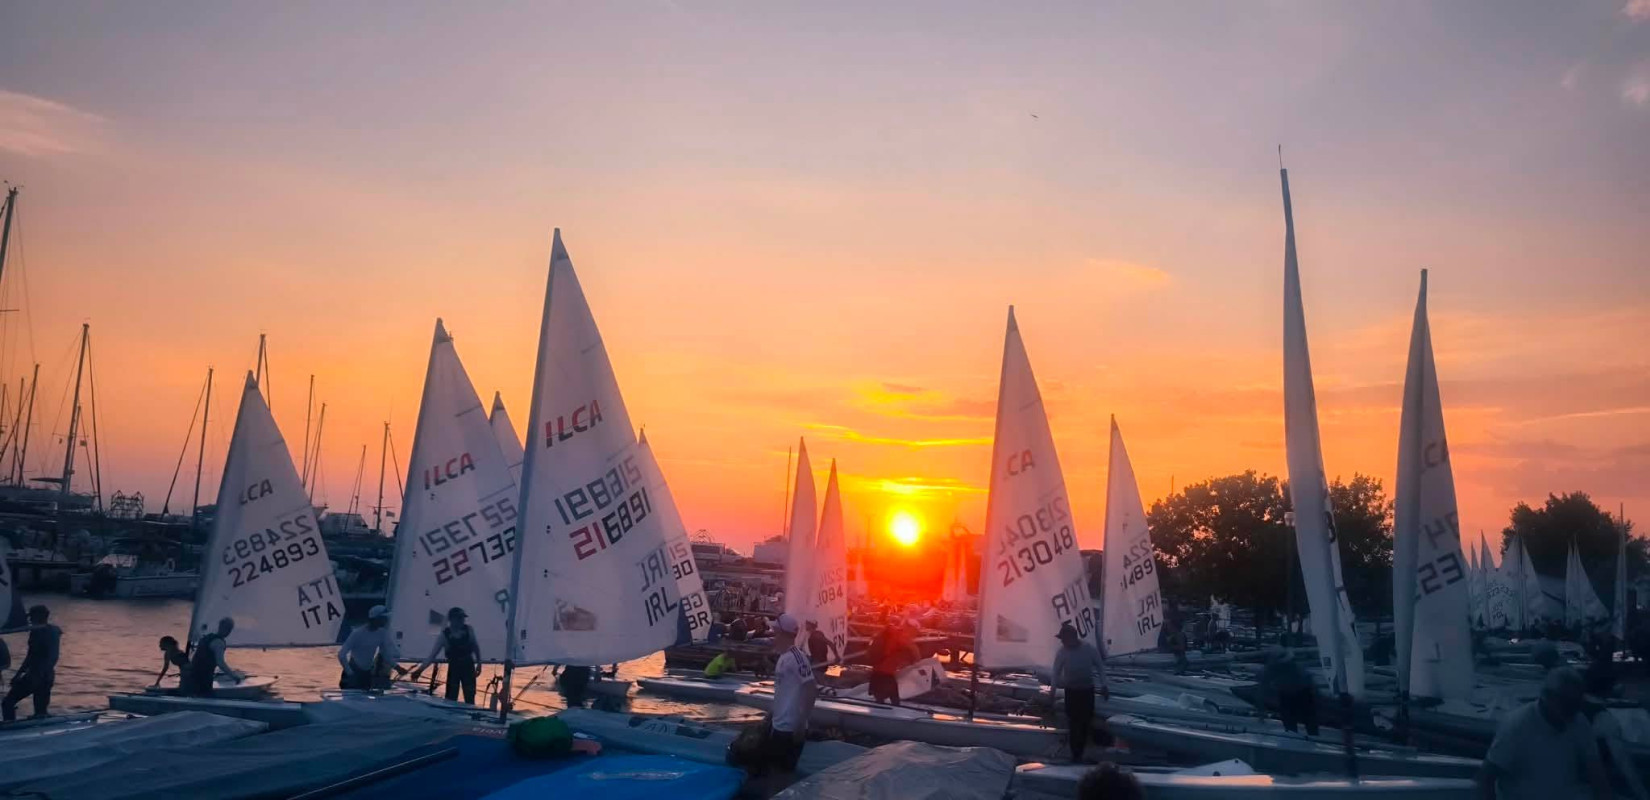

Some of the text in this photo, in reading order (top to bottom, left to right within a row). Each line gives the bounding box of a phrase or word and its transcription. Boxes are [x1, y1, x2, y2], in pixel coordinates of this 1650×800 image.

[545, 400, 603, 448] ILCA
[424, 453, 475, 490] ILCA
[569, 487, 652, 561] 216891
[228, 537, 319, 588] 224893
[997, 524, 1073, 587] 213048
[301, 601, 341, 629] ITA
[644, 586, 678, 627] IRL
[1136, 612, 1162, 636] IRL
